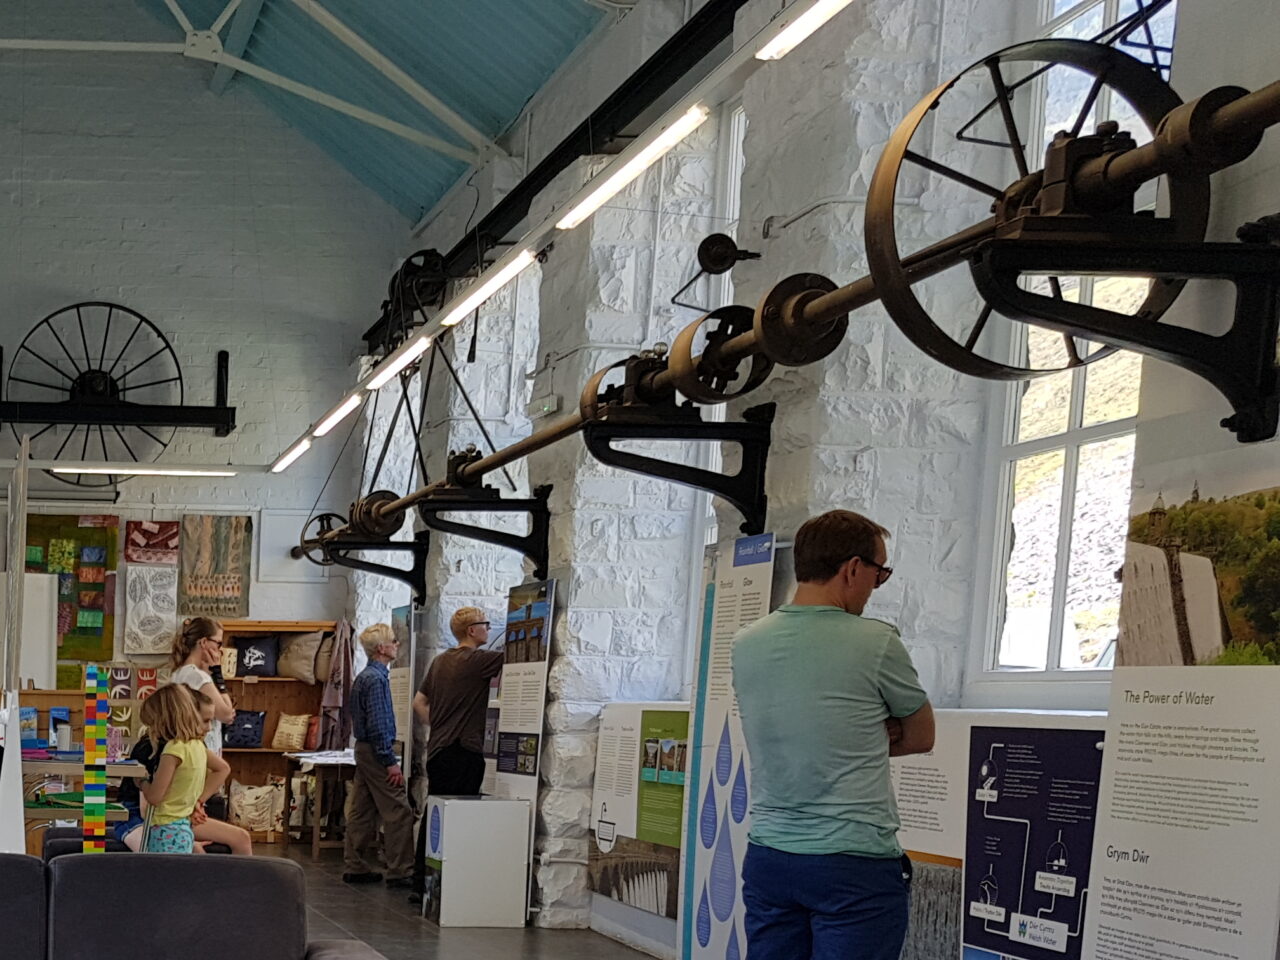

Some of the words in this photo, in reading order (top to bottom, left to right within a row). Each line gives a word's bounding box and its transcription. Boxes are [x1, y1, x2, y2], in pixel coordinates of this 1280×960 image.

[1124, 690, 1140, 704] The
[1142, 690, 1170, 704] Power
[1172, 690, 1184, 704] of
[1185, 692, 1215, 706] Water
[1106, 845, 1130, 862] Grym
